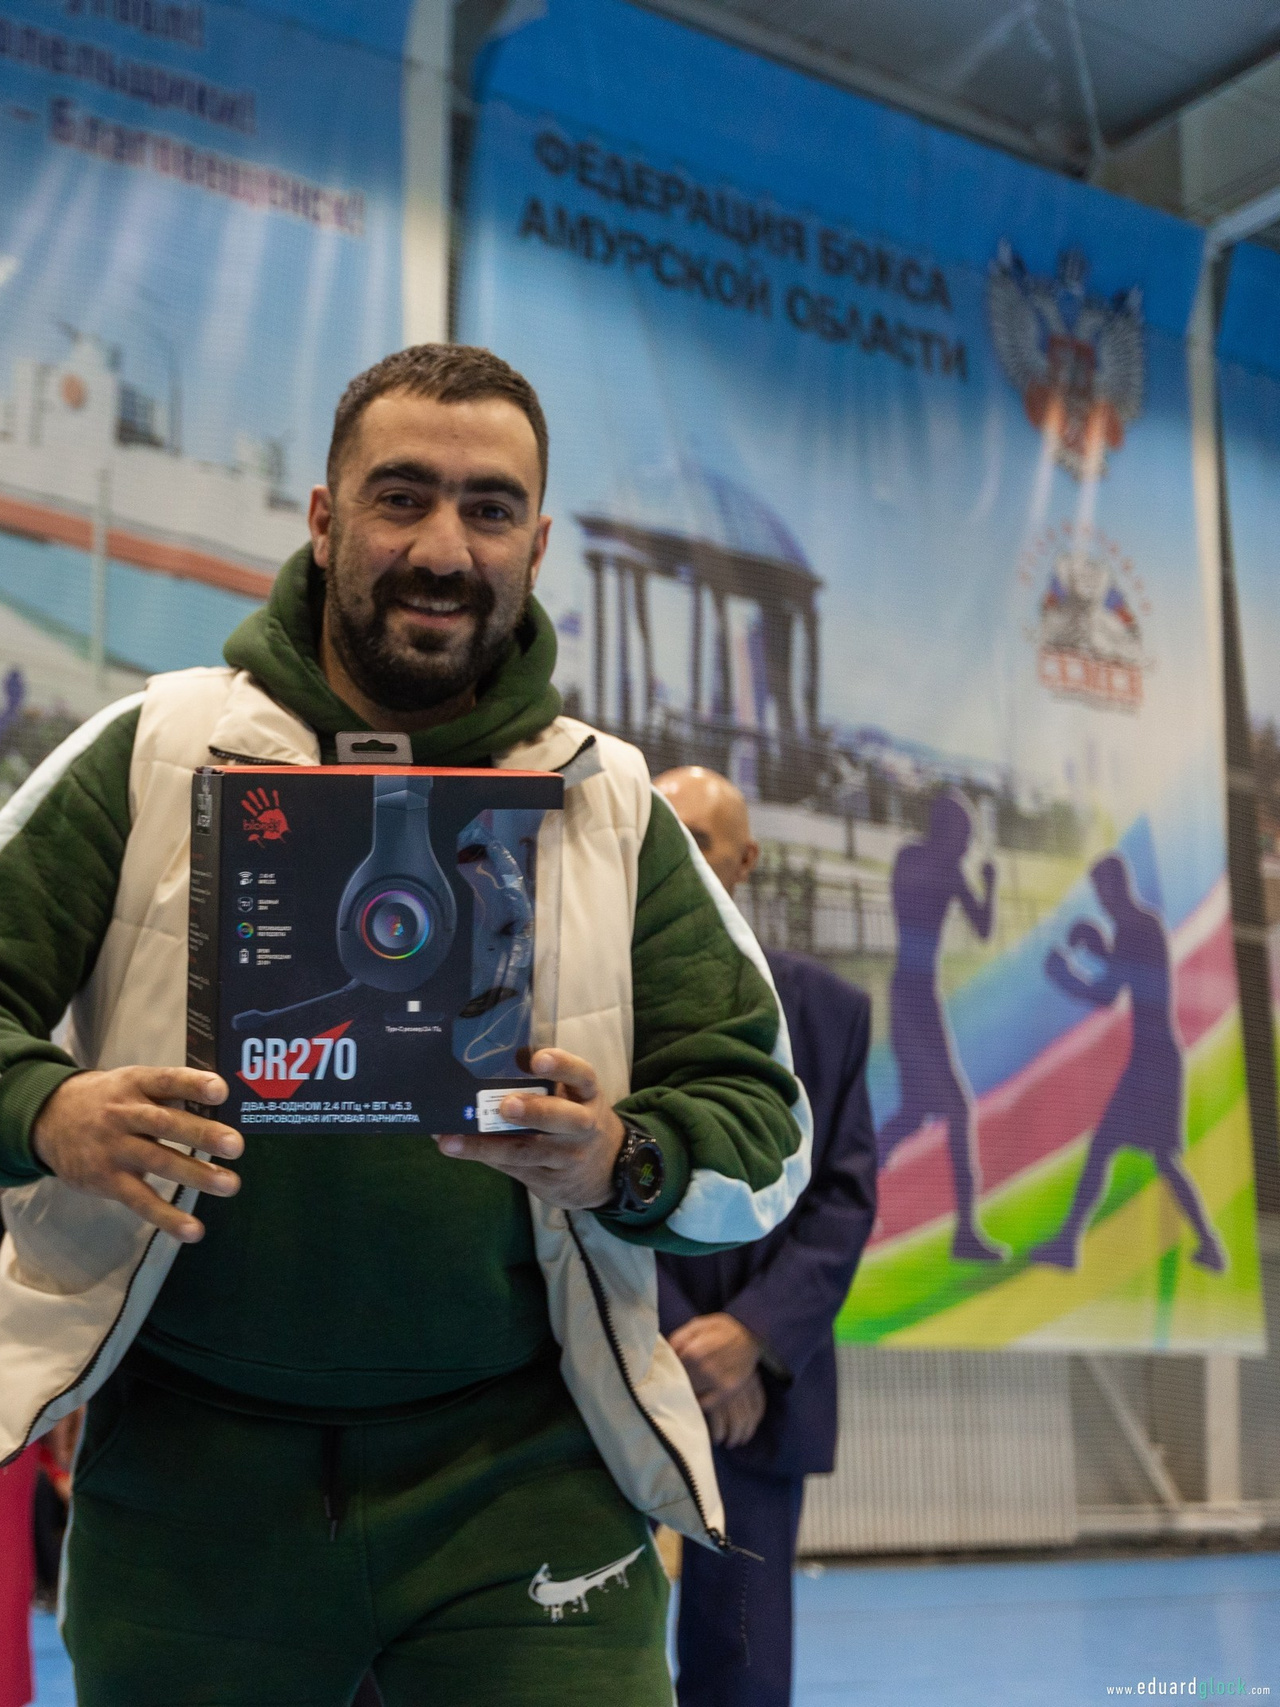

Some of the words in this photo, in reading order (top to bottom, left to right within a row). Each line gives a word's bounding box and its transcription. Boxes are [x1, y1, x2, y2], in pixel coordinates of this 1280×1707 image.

[533, 129, 807, 263] ФЕДЕРАЦИЯ
[819, 227, 952, 312] БОКСА
[520, 199, 774, 319] АМУРСКОЙ
[785, 286, 968, 382] ОБЛАСТИ
[241, 1037, 358, 1080] GR270
[240, 1101, 321, 1112] ДВА-В-ОДНОМ
[322, 1101, 340, 1111] 2.4
[341, 1101, 361, 1112] ГГц
[240, 1114, 320, 1124] БЕСПРОВОДНАЯ
[321, 1114, 365, 1123] ИГРОВАЯ
[366, 1114, 420, 1123] ГАРНИТУРА
